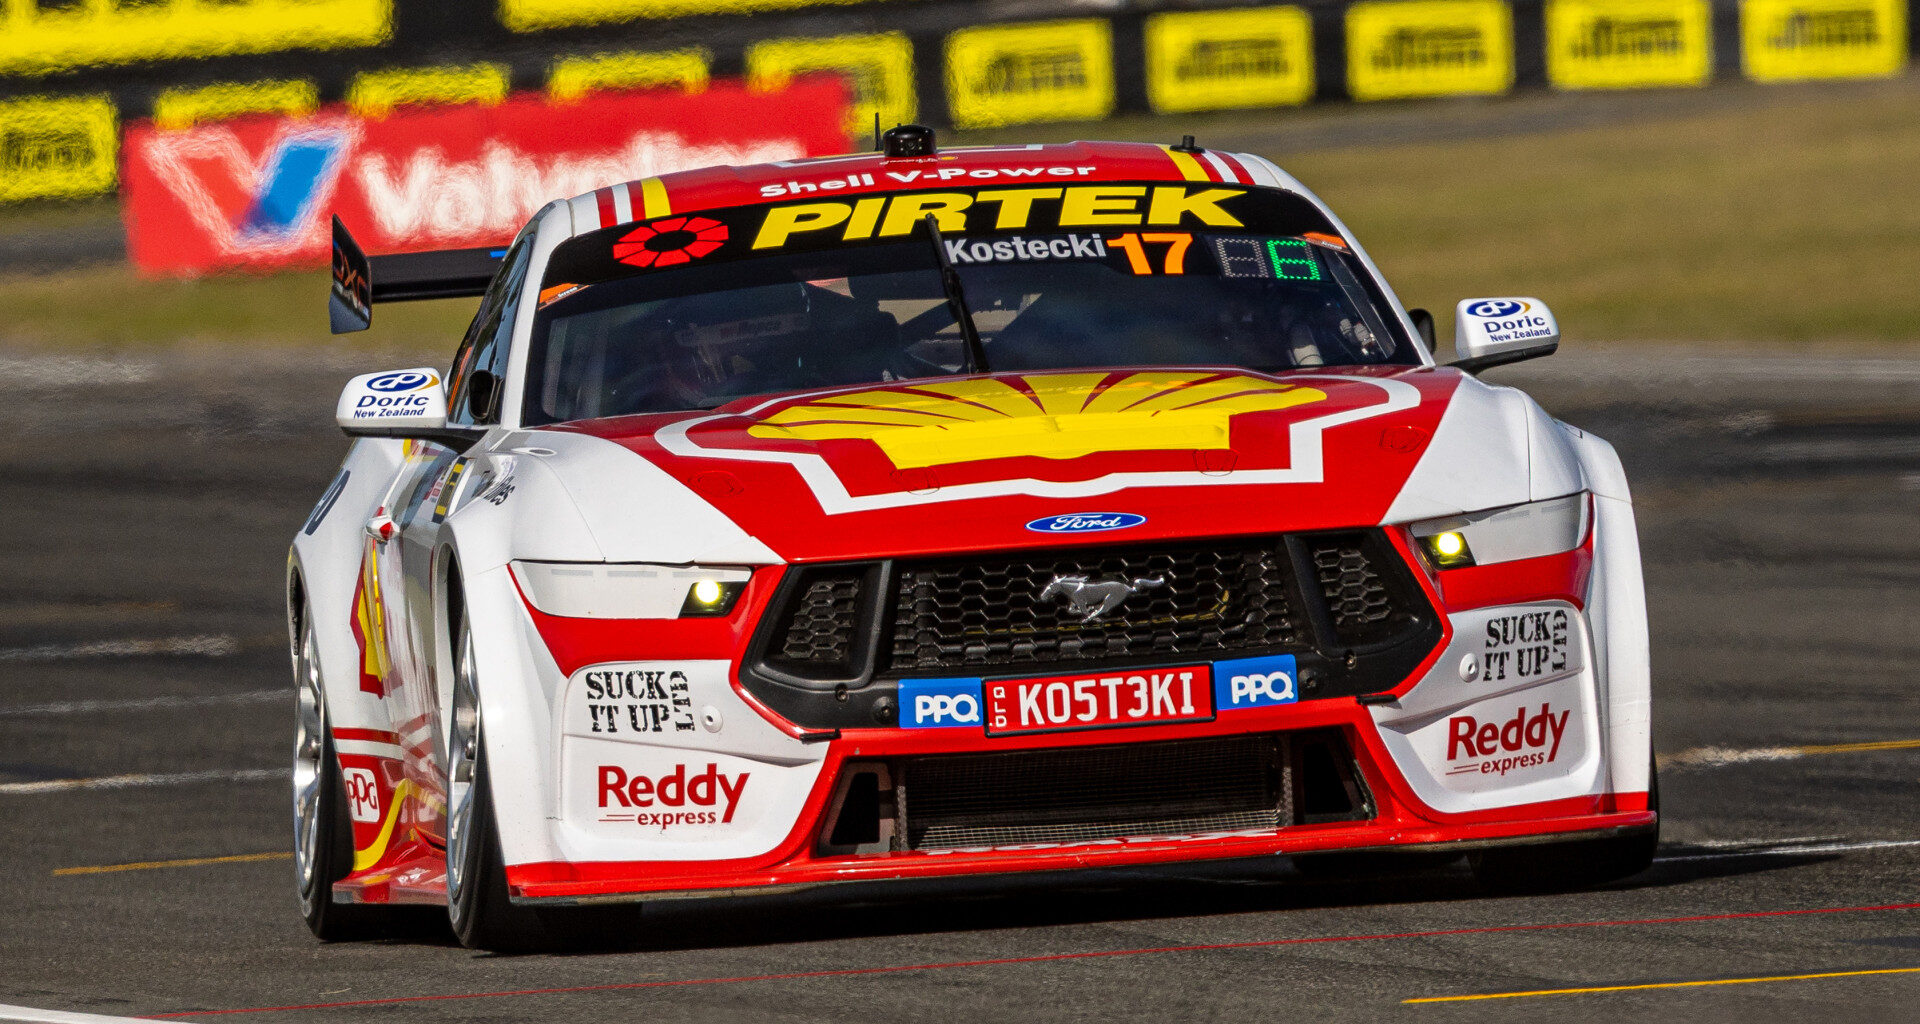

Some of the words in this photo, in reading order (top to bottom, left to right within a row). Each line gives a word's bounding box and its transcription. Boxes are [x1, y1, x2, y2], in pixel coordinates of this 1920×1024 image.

[760, 173, 875, 198] Shell
[886, 166, 1096, 184] V-Power
[751, 186, 1246, 250] PIRTEK
[944, 233, 1104, 265] Kostecki
[1107, 232, 1193, 275] 17
[1483, 315, 1546, 334] Doric
[1490, 332, 1512, 343] New
[1512, 327, 1551, 340] Zealand
[353, 409, 376, 419] New
[378, 407, 426, 417] Zealand
[356, 394, 430, 408] Doric
[1049, 514, 1122, 531] Ford
[1486, 611, 1551, 648] SUCK
[1552, 610, 1567, 672] LTD
[1482, 651, 1510, 682] IT
[1516, 645, 1551, 678] UP
[585, 670, 669, 700] SUCK
[669, 670, 696, 732] LTD
[1231, 671, 1294, 704] PPQ
[588, 704, 620, 733] IT
[627, 703, 670, 733] UP
[914, 693, 980, 723] PPQ
[993, 686, 1007, 728] QLD
[1447, 703, 1570, 762] Reddy
[1480, 751, 1545, 775] express
[598, 762, 751, 823] Reddy
[637, 811, 717, 830] express
